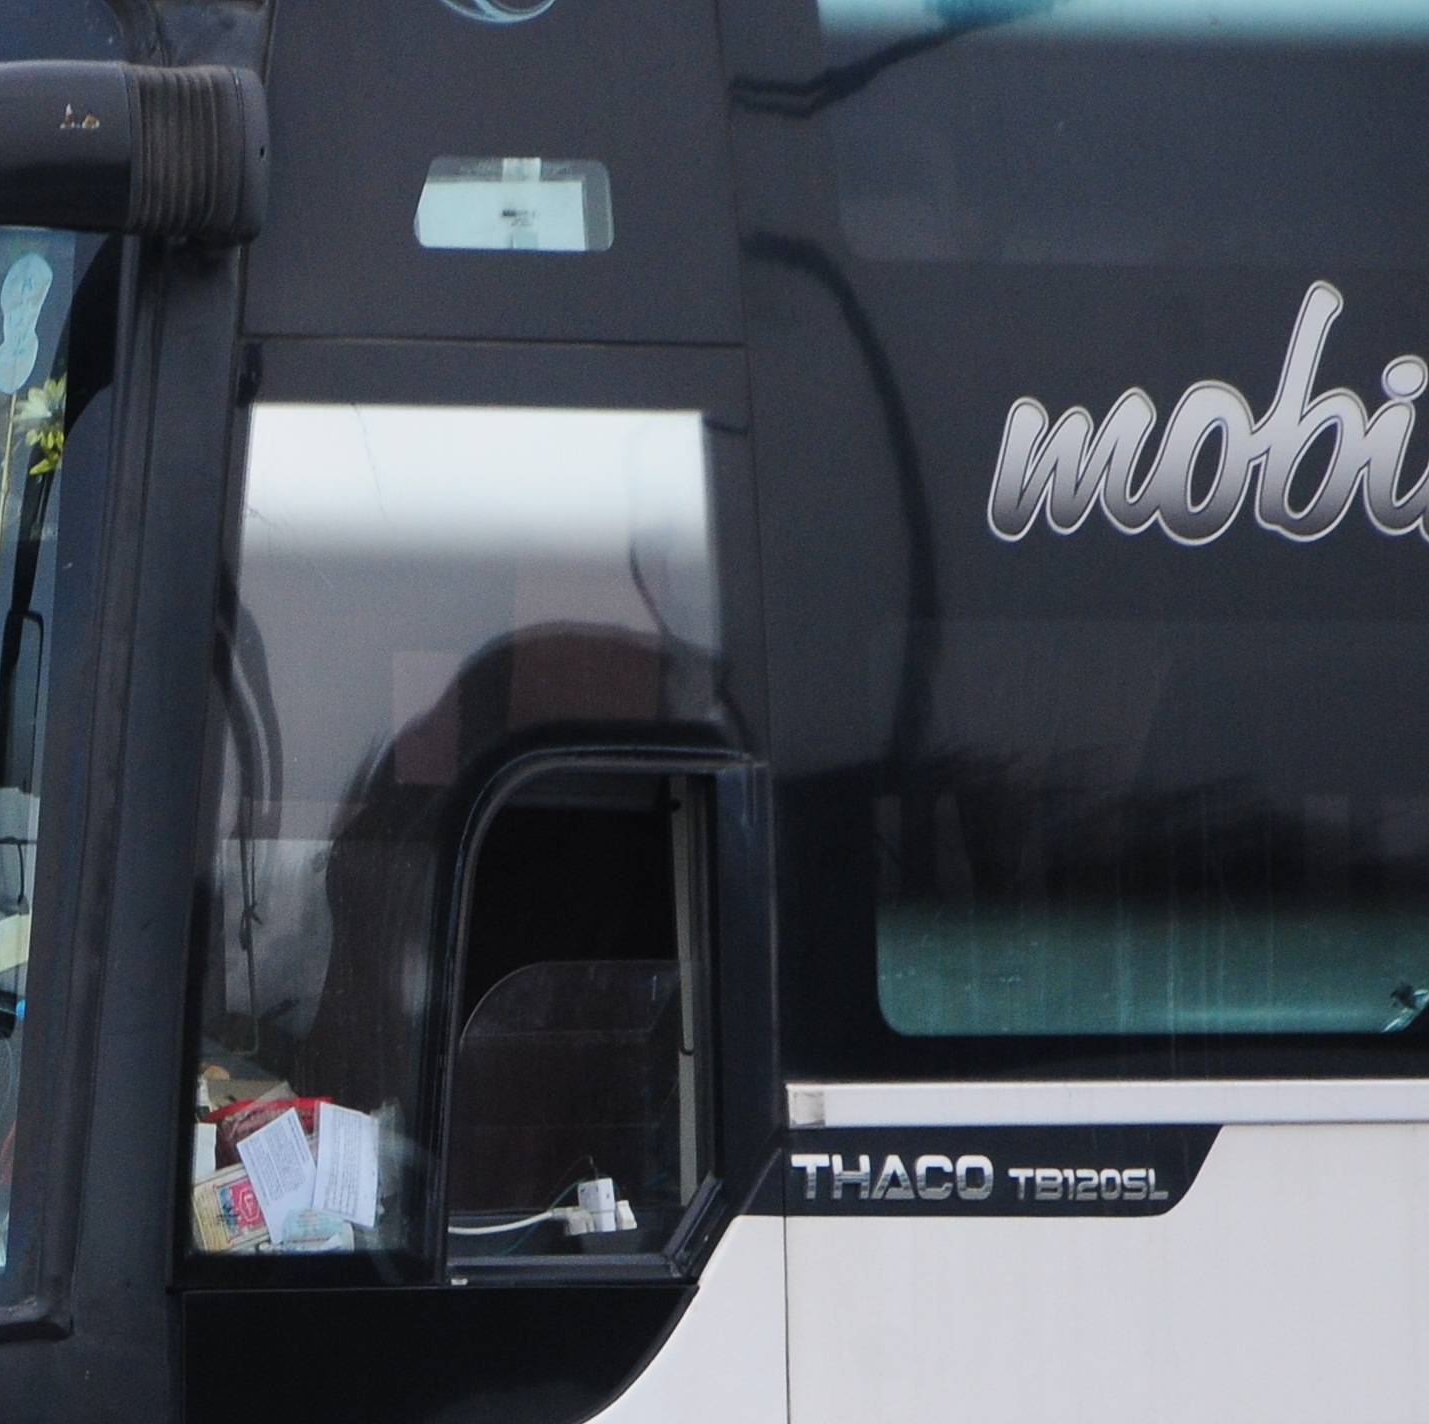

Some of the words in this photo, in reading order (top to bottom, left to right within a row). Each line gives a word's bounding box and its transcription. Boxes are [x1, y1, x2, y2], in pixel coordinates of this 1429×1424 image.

[987, 279, 1429, 547] mobi
[791, 1154, 994, 1200] THACO
[1008, 1167, 1169, 1200] TB120SL
